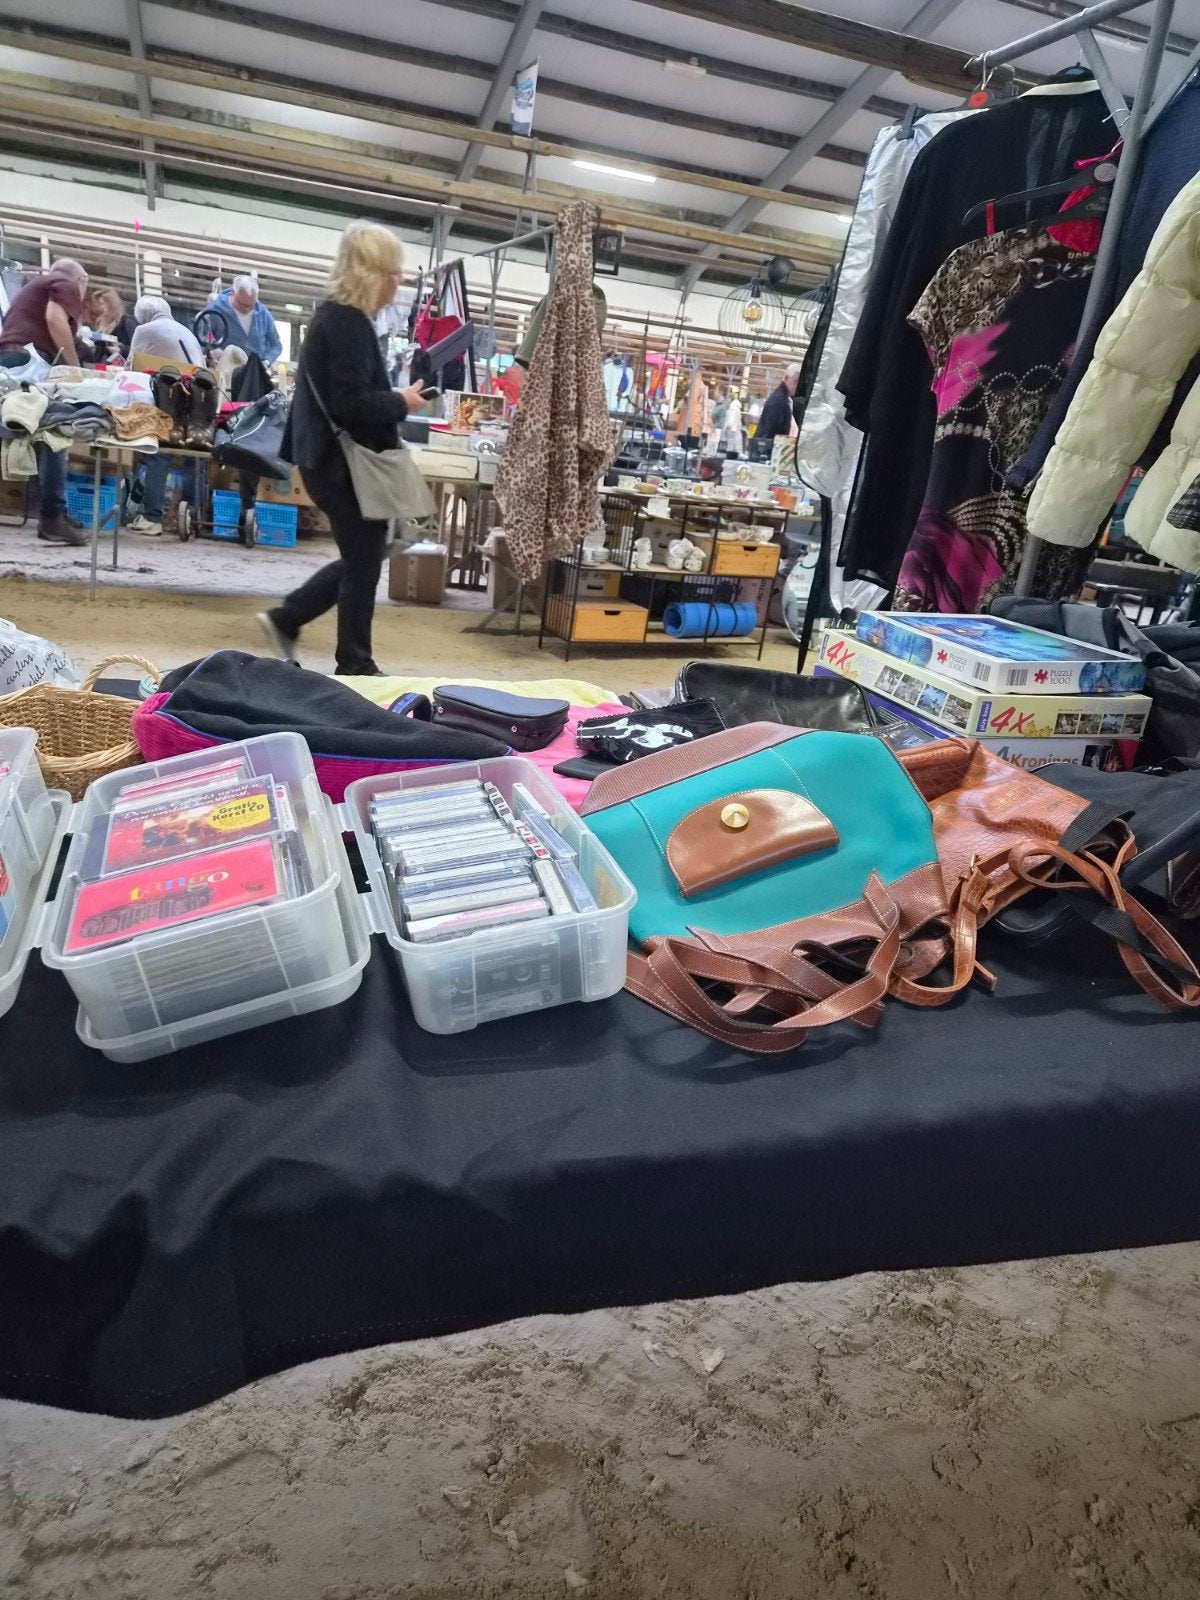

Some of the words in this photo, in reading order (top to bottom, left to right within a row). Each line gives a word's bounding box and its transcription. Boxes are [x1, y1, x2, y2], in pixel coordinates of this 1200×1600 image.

[1049, 676, 1071, 685] 1000
[212, 808, 246, 821] Kerst
[249, 803, 265, 812] CD
[219, 801, 258, 814] Gratis
